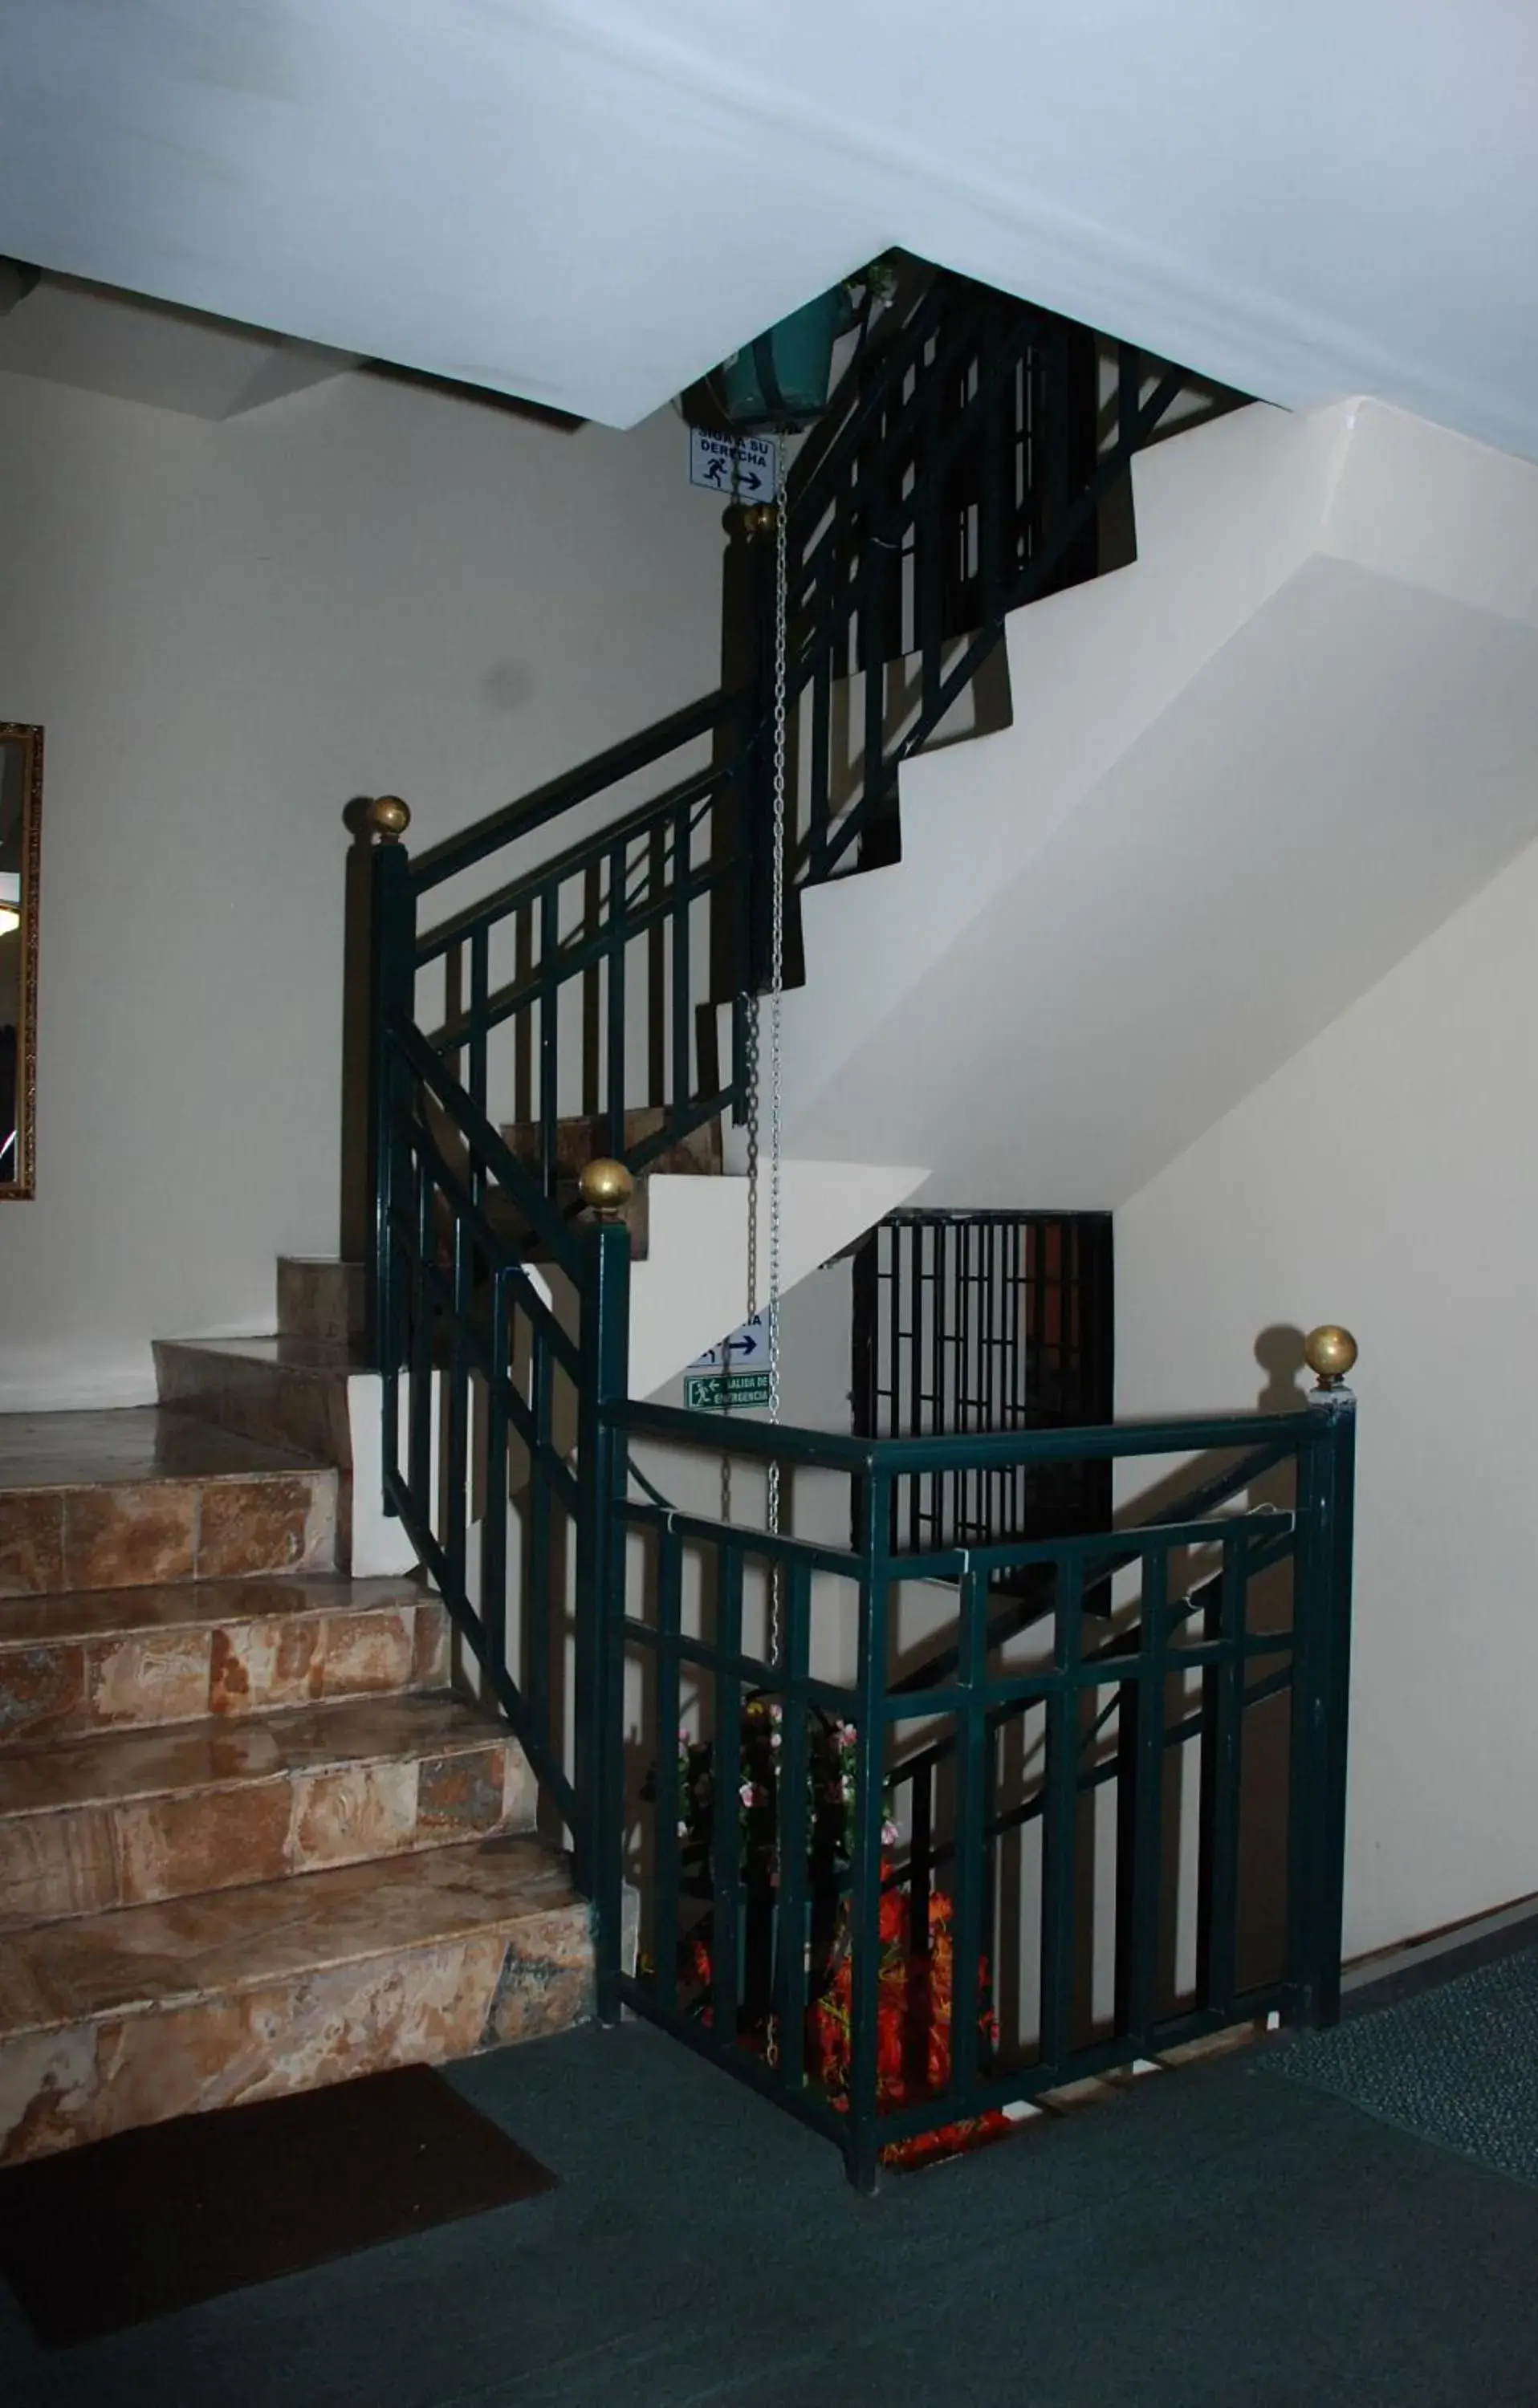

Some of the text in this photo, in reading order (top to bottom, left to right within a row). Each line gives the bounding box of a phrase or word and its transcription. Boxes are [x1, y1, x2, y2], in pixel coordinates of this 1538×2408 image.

[701, 439, 767, 467] DERECHA
[751, 441, 767, 454] SU
[757, 1377, 767, 1388] DE
